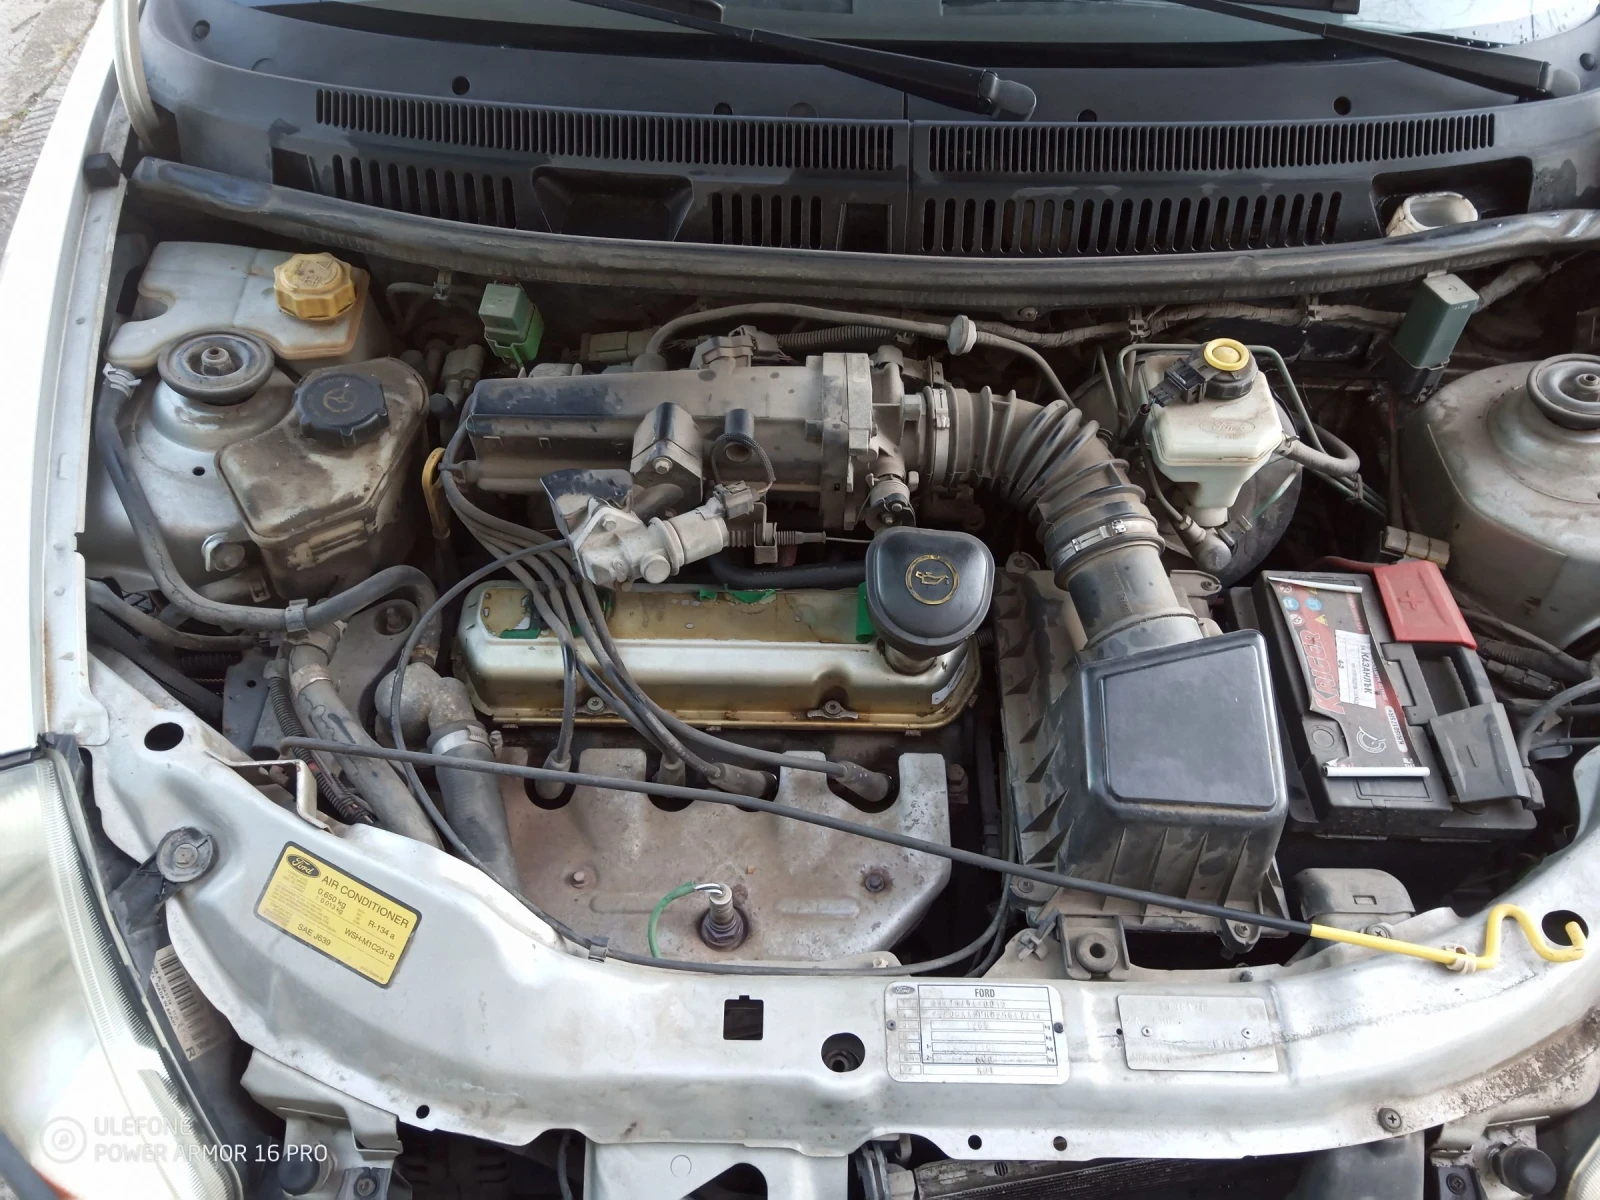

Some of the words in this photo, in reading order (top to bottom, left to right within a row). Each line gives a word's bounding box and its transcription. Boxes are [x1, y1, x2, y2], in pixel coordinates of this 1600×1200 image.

[1361, 651, 1373, 694] КАЗАНЛЪК
[291, 858, 315, 875] Ford
[318, 888, 338, 902] 0.650
[338, 899, 346, 910] kg
[321, 876, 340, 890] AIR
[340, 886, 410, 928] CONDITIONER
[336, 908, 344, 916] kg
[297, 923, 314, 937] SAE
[313, 933, 332, 946] J639
[368, 920, 390, 936] R-134
[344, 928, 396, 961] WSH-M1C231-B
[974, 988, 996, 998] FORD
[186, 1046, 196, 1059] R
